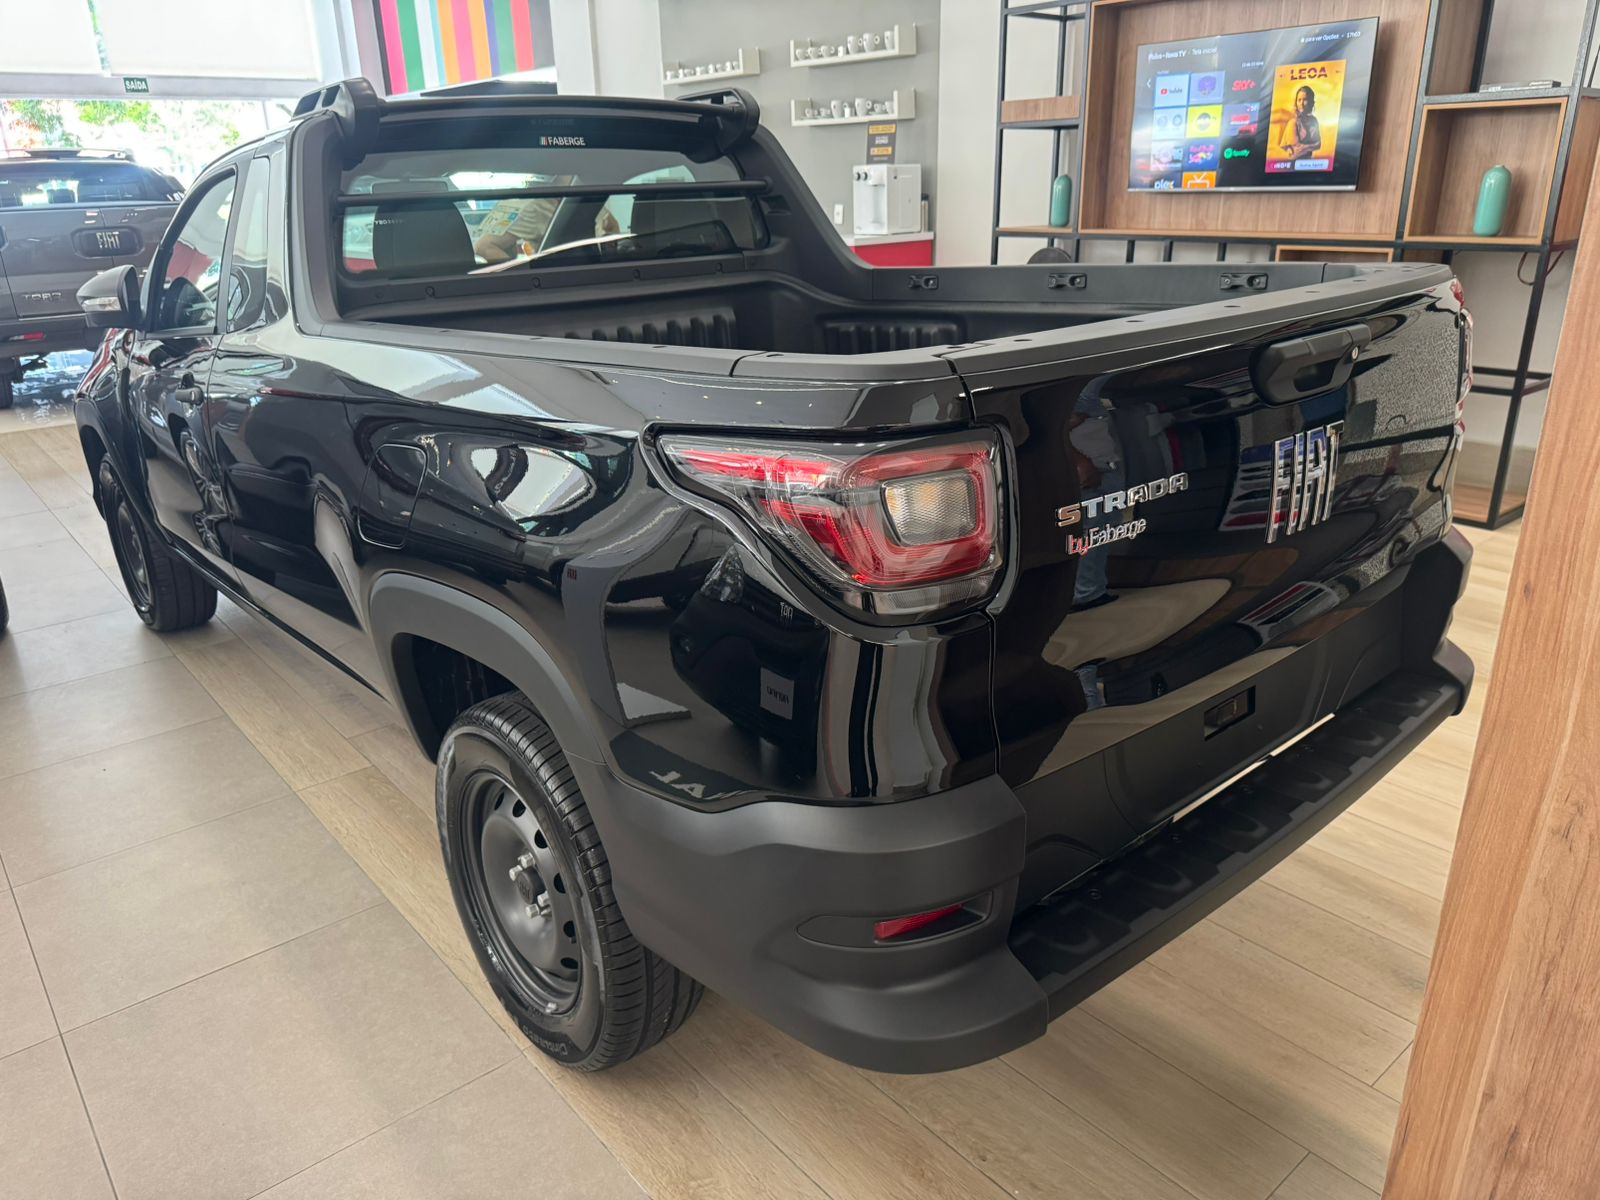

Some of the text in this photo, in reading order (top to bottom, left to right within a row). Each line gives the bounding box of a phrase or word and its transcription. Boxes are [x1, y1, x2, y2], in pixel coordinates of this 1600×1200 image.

[1290, 66, 1328, 80] LEOA
[125, 78, 148, 91] SAÍDA
[547, 136, 586, 146] FABERGE
[1154, 178, 1175, 189] plex
[96, 231, 121, 249] FIAT
[1264, 419, 1345, 544] FIAT
[1056, 471, 1189, 527] STRADA
[1066, 516, 1147, 556] by Faberge
